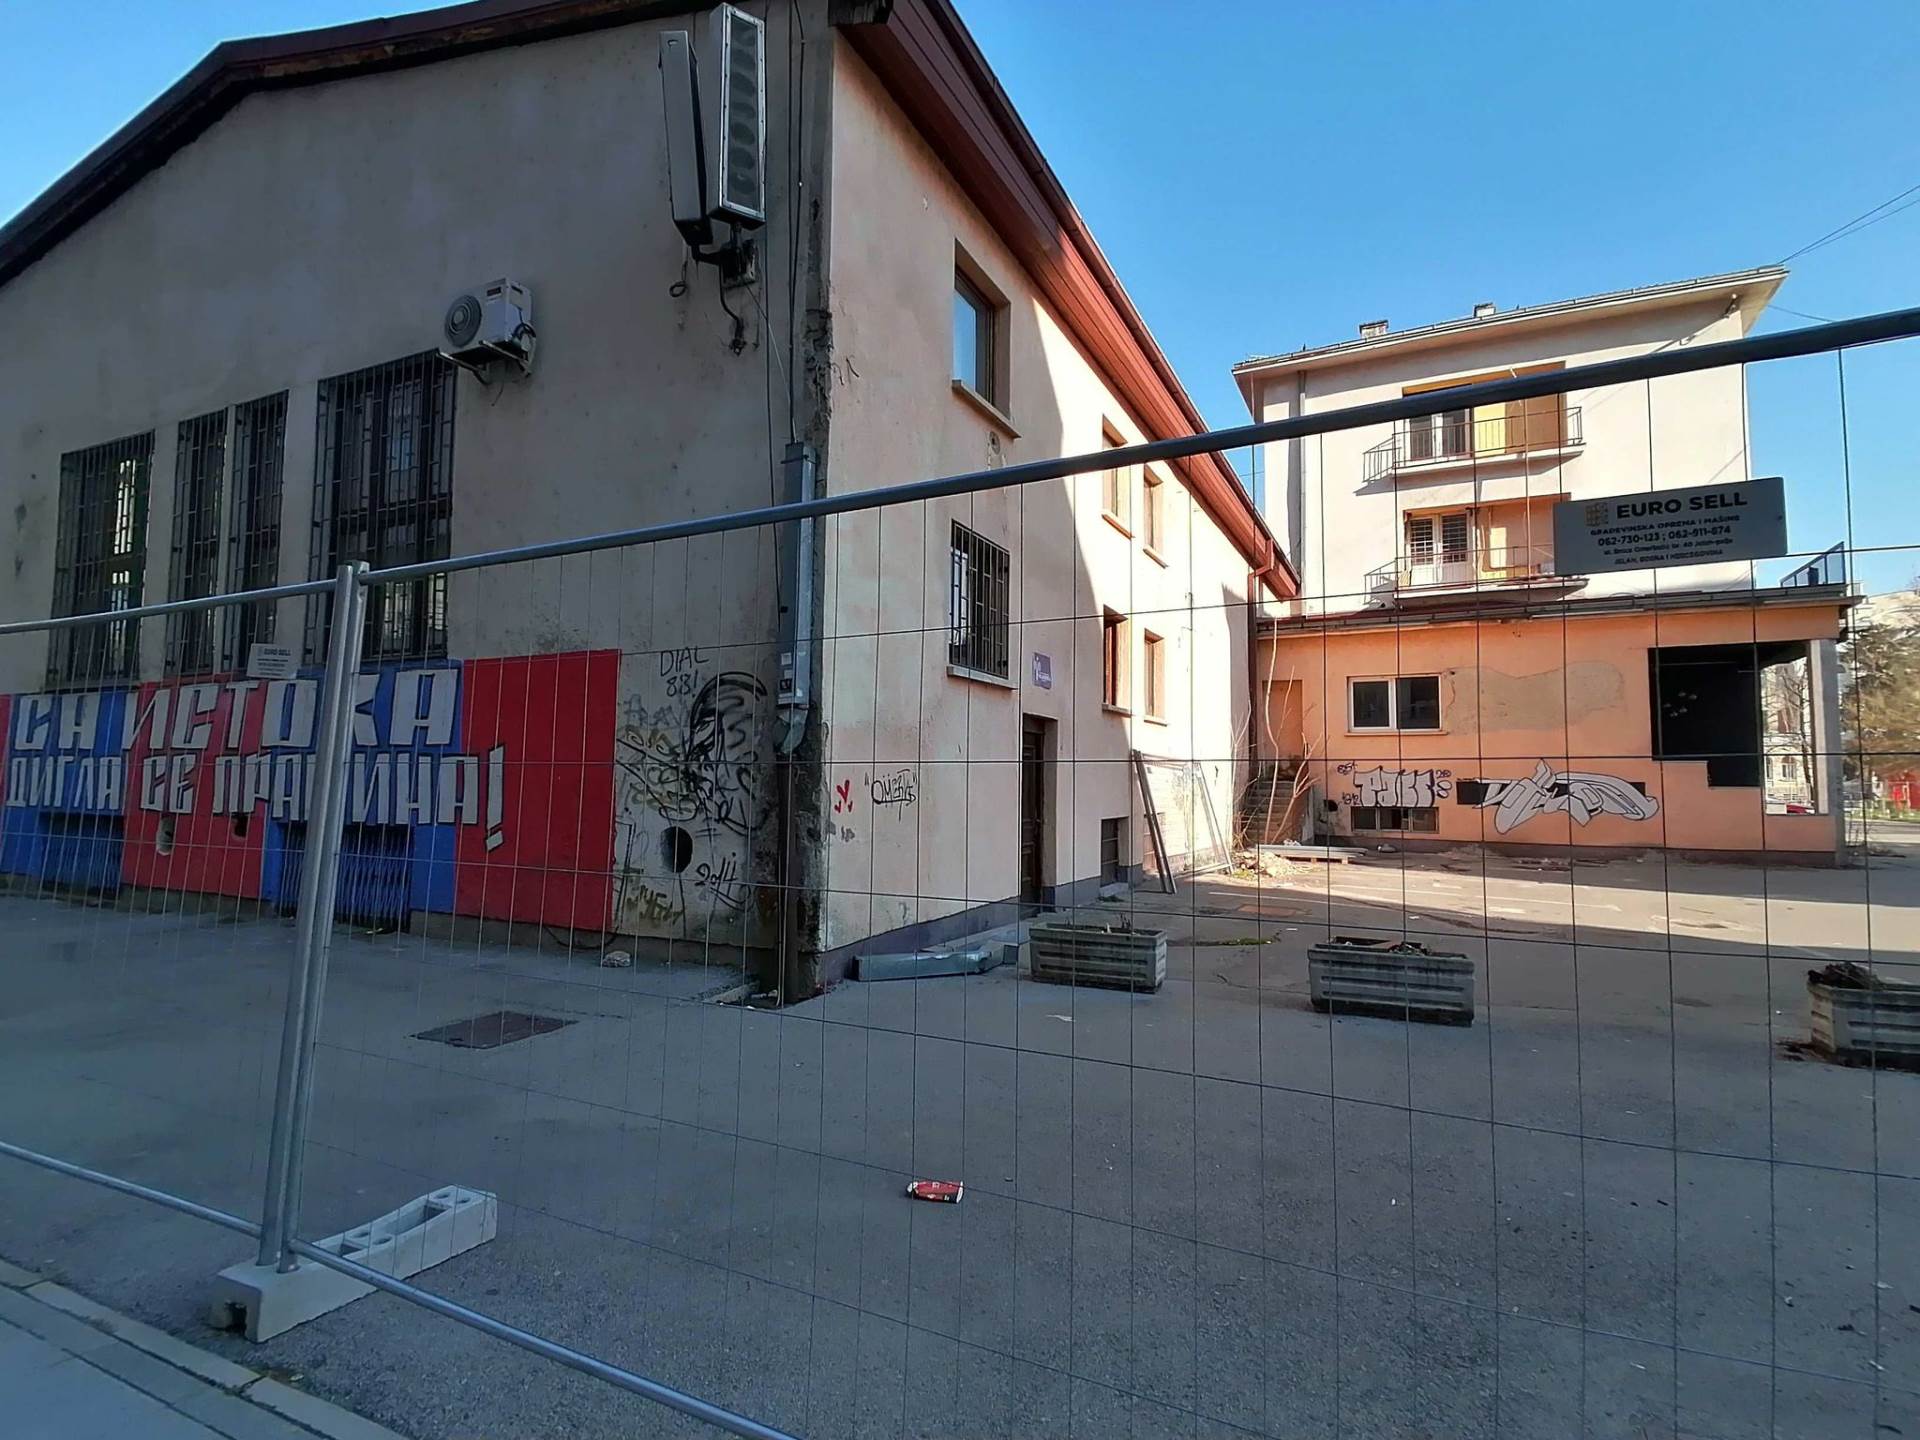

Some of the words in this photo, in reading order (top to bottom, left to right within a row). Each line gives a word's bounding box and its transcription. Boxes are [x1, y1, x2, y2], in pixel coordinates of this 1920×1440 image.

[1616, 498, 1682, 519] EURO
[1690, 492, 1748, 510] SELL
[1598, 531, 1660, 547] 062-730-123
[660, 646, 709, 677] DIAL
[6, 755, 122, 811] ДИГЛА
[140, 754, 197, 814] СЕ
